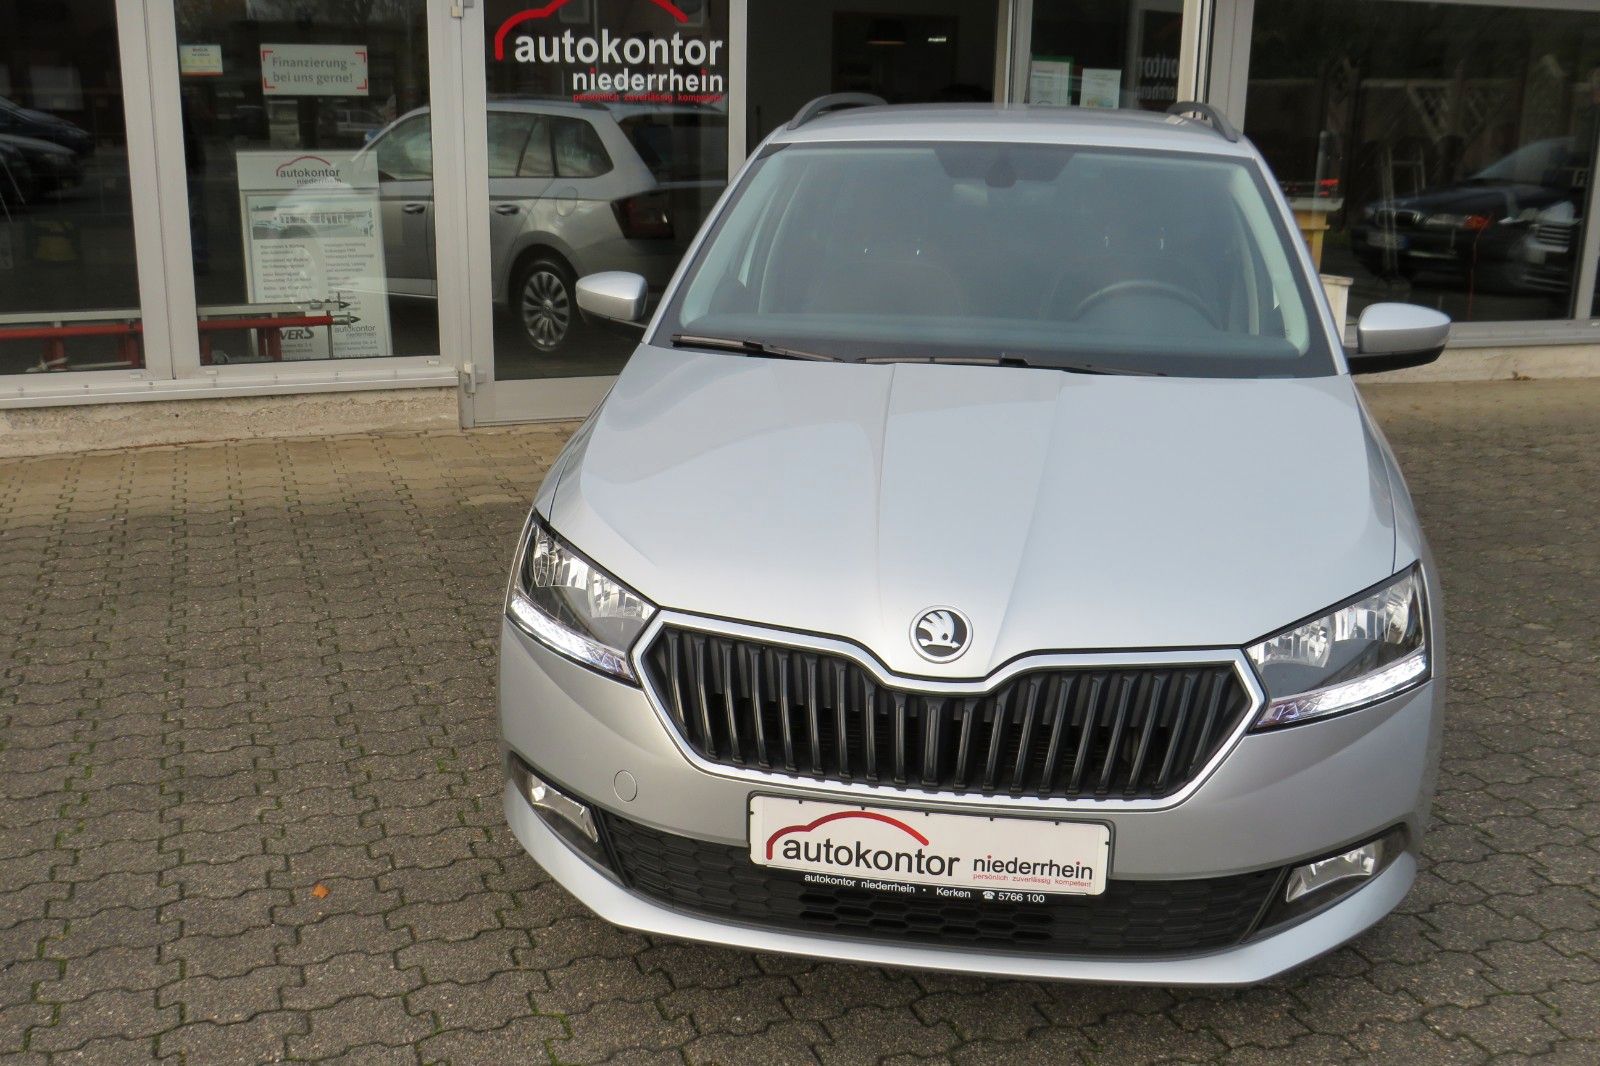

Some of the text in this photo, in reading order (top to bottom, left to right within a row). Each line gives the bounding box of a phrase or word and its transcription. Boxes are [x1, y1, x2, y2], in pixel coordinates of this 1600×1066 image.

[514, 28, 723, 66] autokontor
[272, 57, 347, 71] Finanzierung
[273, 72, 353, 85] bei uns gerne!
[572, 67, 723, 92] niederrhein
[280, 168, 340, 178] autokontor
[280, 327, 315, 340] VERS
[783, 838, 1093, 880] autokontor niederrhein
[804, 873, 1045, 903] autokontor niederrhein Kerken 5766 100
[973, 873, 1091, 888] persönlich zuverlässig kompetent
